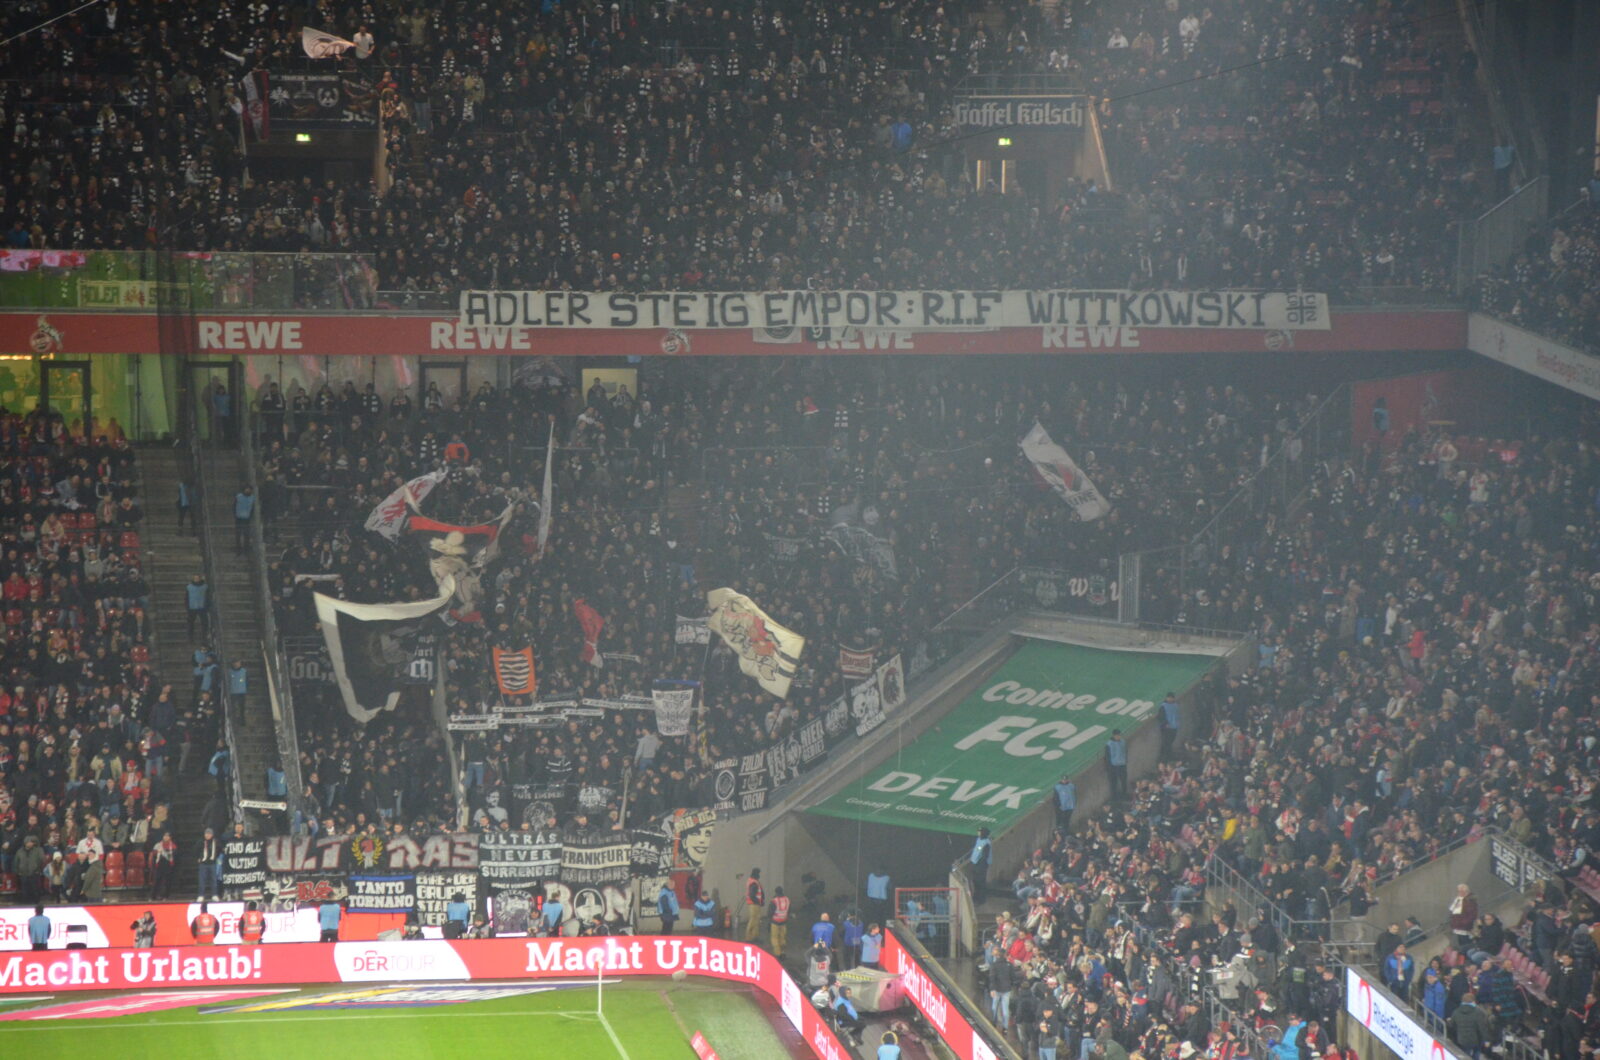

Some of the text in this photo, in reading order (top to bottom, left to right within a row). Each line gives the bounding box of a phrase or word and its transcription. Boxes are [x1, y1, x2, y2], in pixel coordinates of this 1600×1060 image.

[955, 102, 1083, 127] Gaffel Kölsch
[465, 292, 592, 326] ADLER
[607, 293, 750, 327] STEIG
[1025, 291, 1266, 327] WITTKOWSKI
[198, 320, 303, 350] REWE
[430, 321, 531, 350] REWE
[1042, 325, 1141, 349] REWE
[981, 680, 1097, 711] Come
[953, 715, 1108, 761] FC!
[866, 770, 1040, 810] DEVK
[484, 832, 557, 845] ULTRAS
[490, 849, 553, 862] NEVER
[562, 848, 632, 866] FRANKFURT
[481, 864, 562, 878] SURRENDER
[355, 881, 405, 895] TANTO
[416, 885, 477, 900] GRUPPE
[349, 895, 415, 908] TORNANO
[0, 948, 263, 987] Macht Urlaub!
[352, 954, 436, 973] DERTOUR
[525, 939, 762, 981] Macht Urlaub!
[920, 975, 948, 1033] Urlaub!
